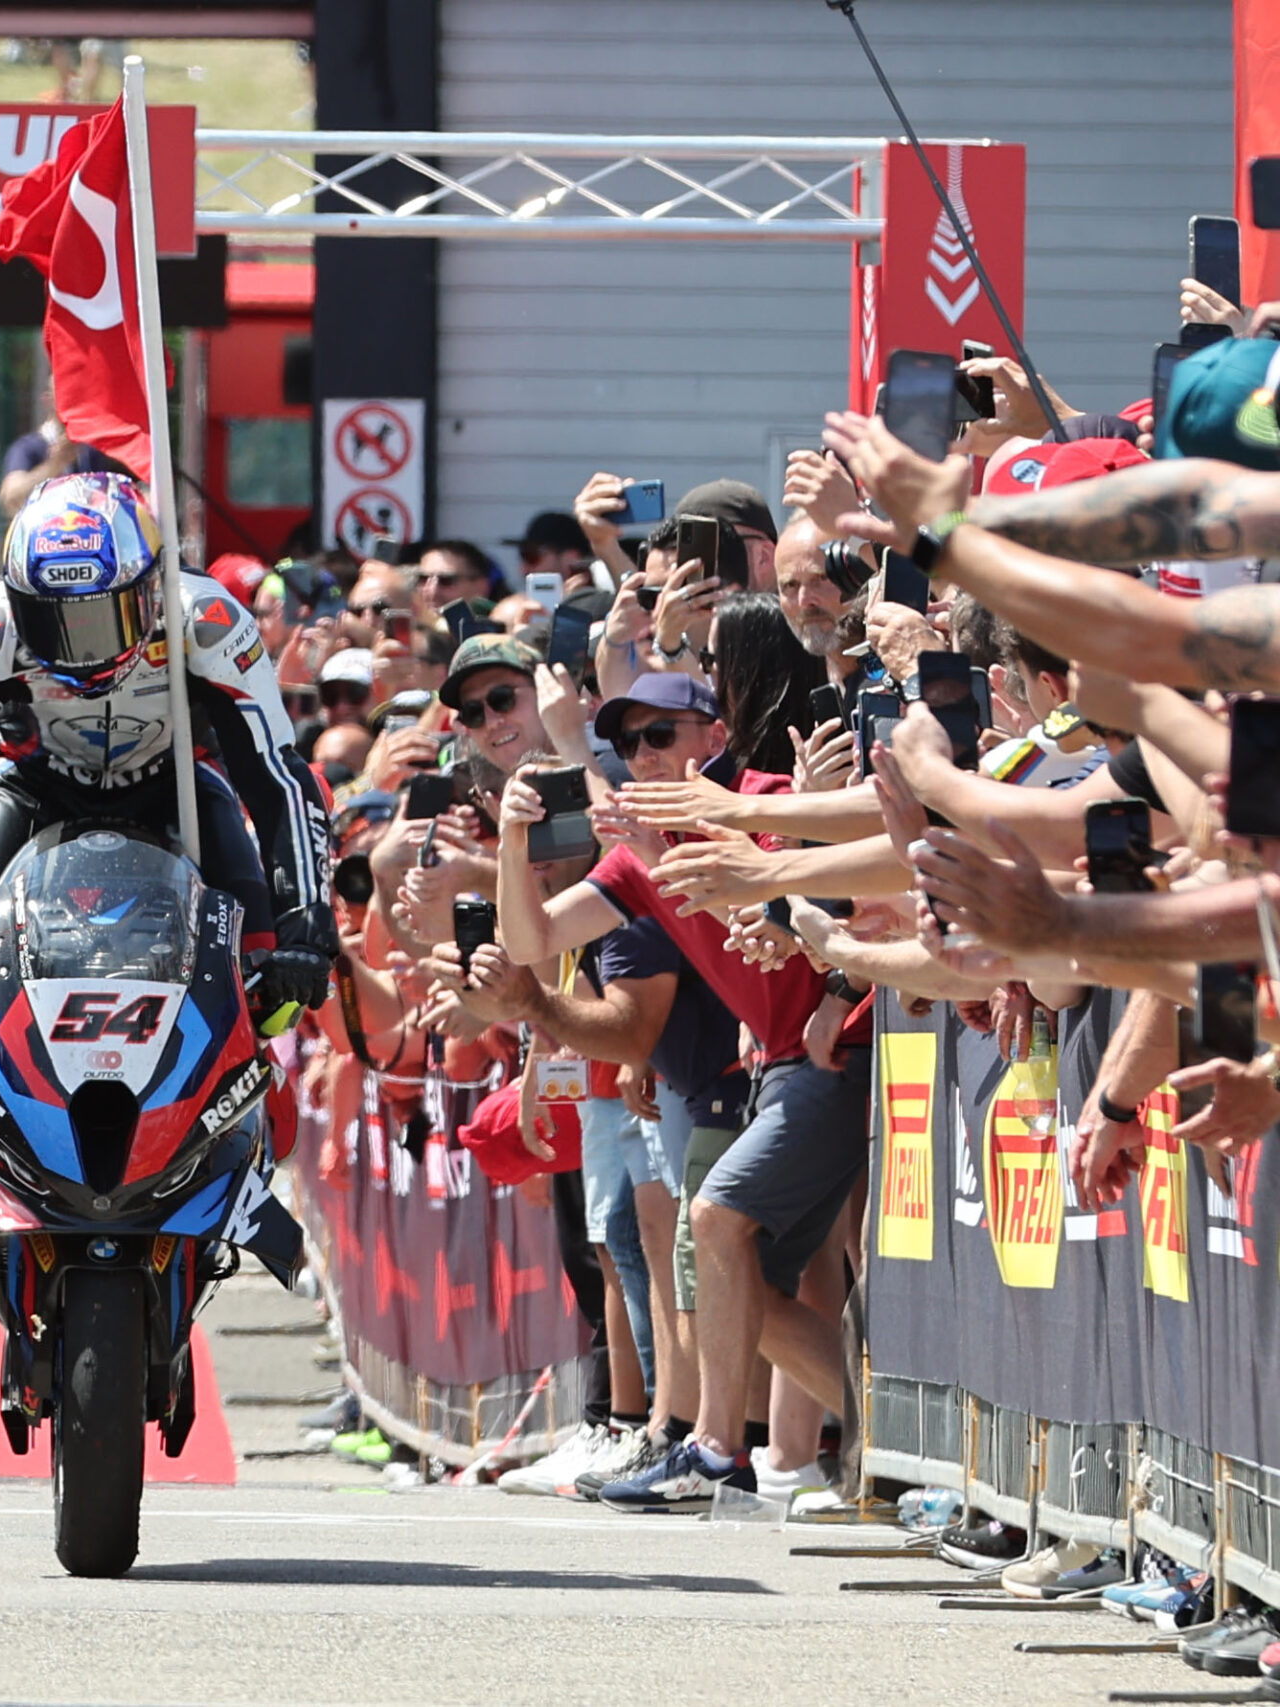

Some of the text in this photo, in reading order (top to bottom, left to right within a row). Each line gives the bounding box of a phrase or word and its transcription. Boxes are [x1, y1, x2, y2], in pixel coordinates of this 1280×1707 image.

[48, 566, 93, 582] SHOEI
[216, 902, 229, 946] EDOX
[49, 991, 169, 1044] 54
